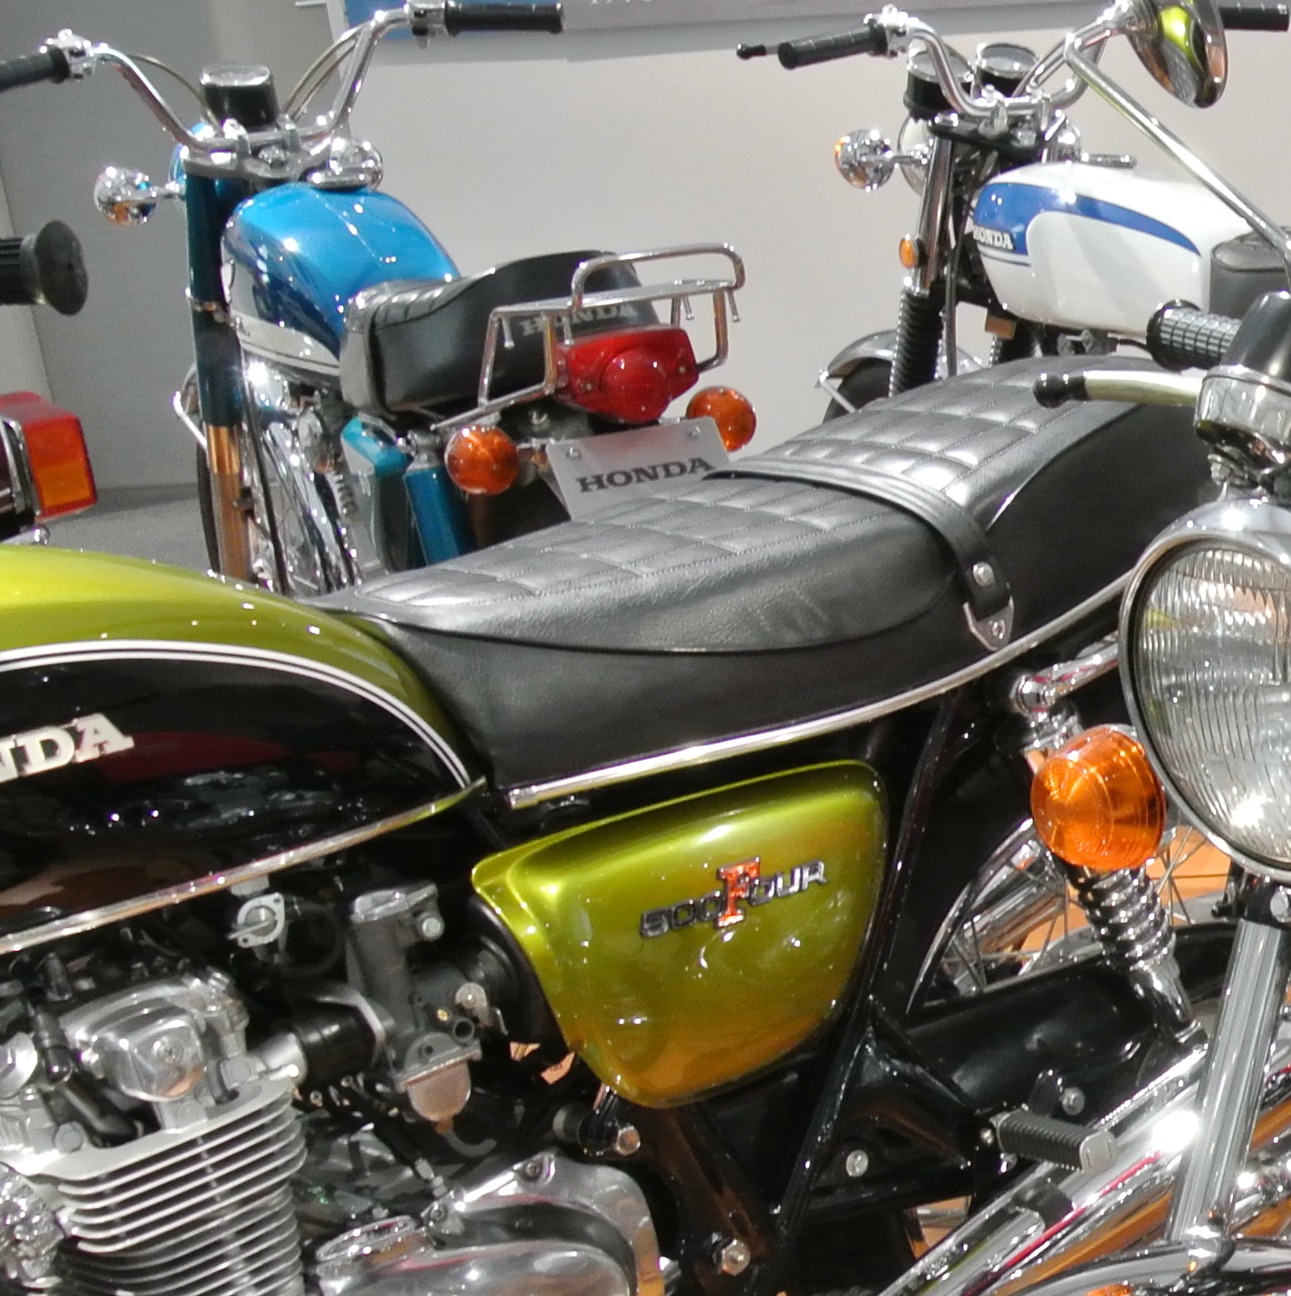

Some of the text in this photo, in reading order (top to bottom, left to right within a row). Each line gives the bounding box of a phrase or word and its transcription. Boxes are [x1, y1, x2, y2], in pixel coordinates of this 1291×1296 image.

[973, 223, 1014, 250] HONDA
[519, 303, 640, 337] HNDA
[576, 456, 718, 493] HONDA
